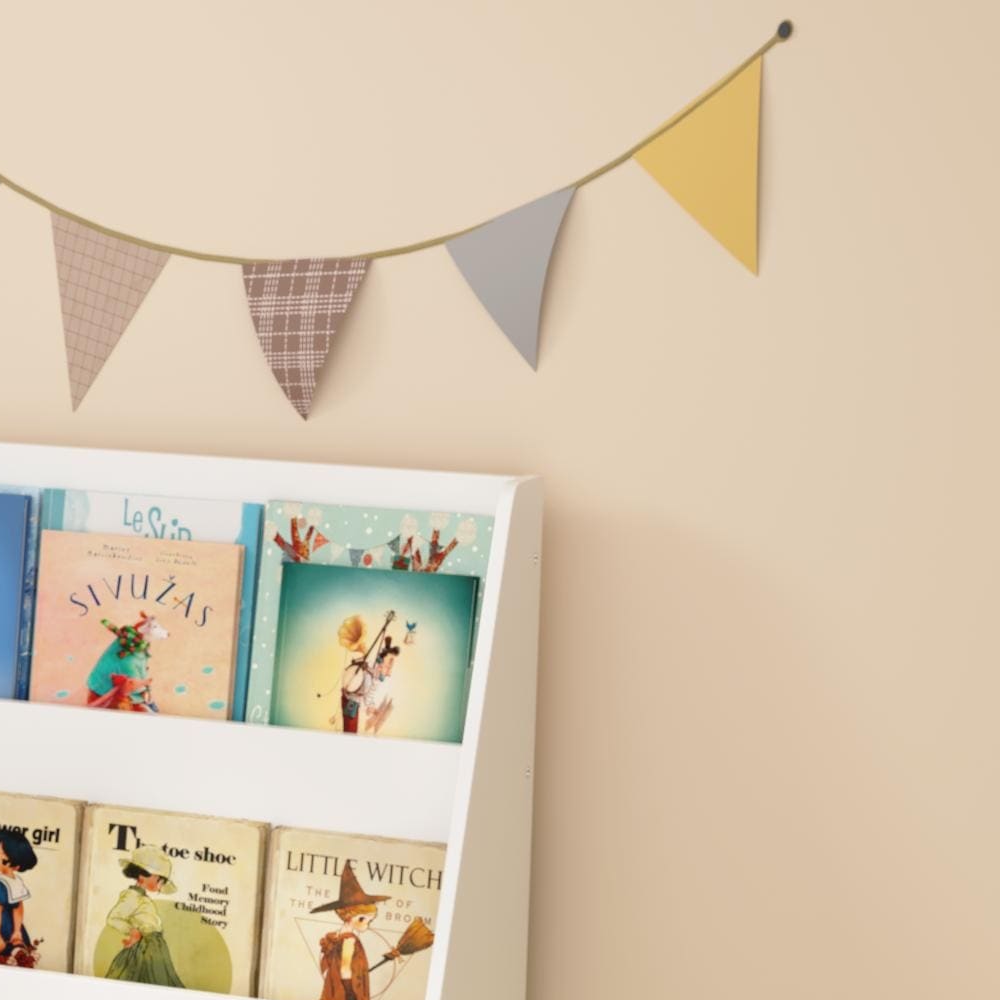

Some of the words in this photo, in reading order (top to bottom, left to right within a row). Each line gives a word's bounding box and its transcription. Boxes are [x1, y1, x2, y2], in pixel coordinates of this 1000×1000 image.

[122, 497, 143, 534] Le
[69, 572, 213, 627] SIVUŽAS
[32, 826, 61, 846] girl
[366, 861, 443, 891] WITCH
[202, 883, 229, 895] Fond
[306, 885, 332, 898] THE
[188, 892, 230, 906] Memory
[396, 900, 413, 910] OF
[174, 901, 227, 917] Childhood
[200, 915, 229, 930] Story
[385, 911, 432, 926] BROM
